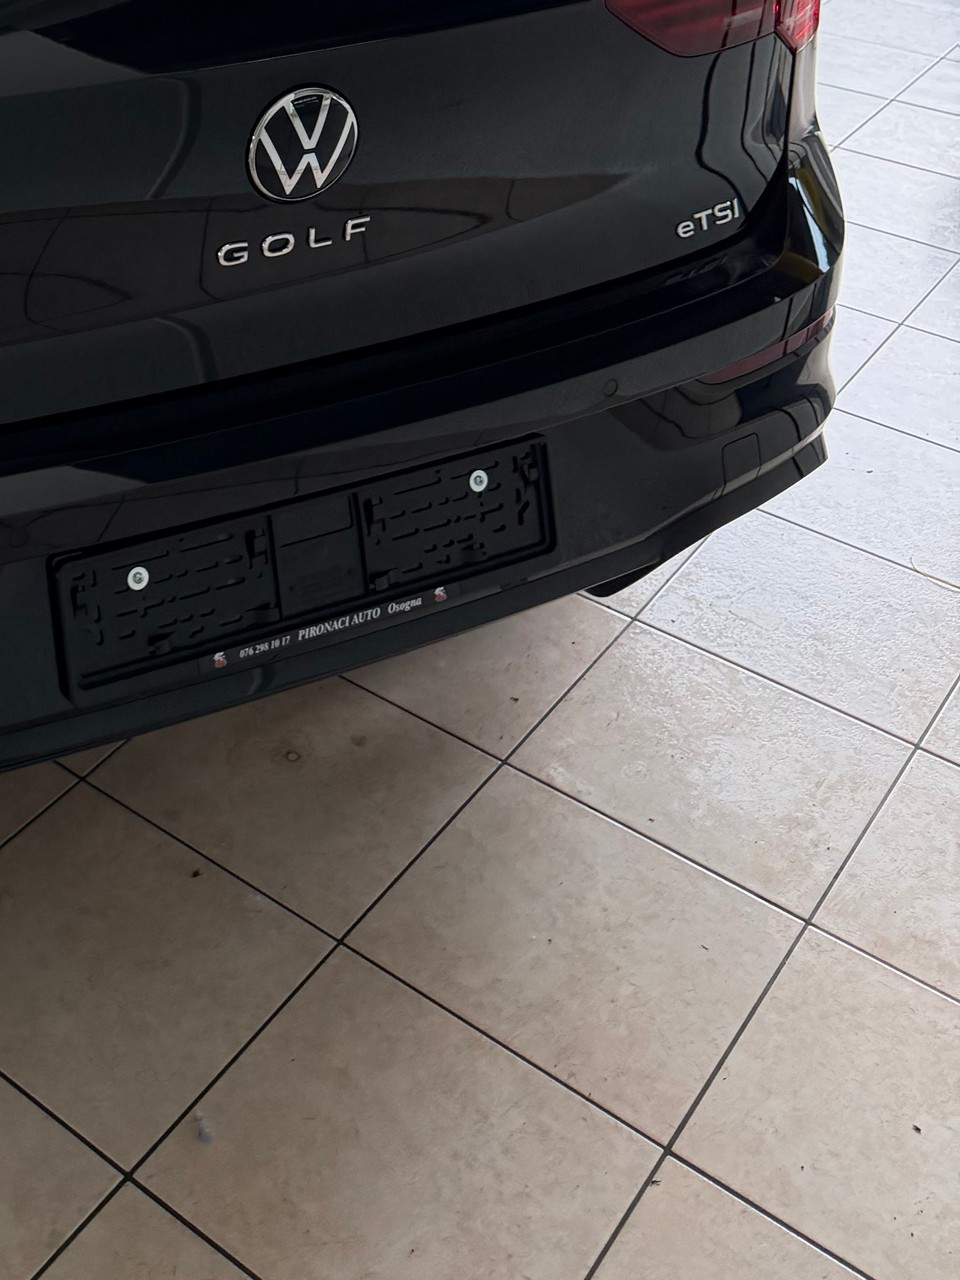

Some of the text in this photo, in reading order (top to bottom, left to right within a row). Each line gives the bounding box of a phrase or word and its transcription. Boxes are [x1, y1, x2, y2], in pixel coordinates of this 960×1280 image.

[250, 87, 358, 201] VW
[216, 214, 373, 267] GOLF
[676, 198, 740, 238] eTSI
[239, 596, 423, 658] 076 298 10 17 PIRONACI AUTO Osogna
